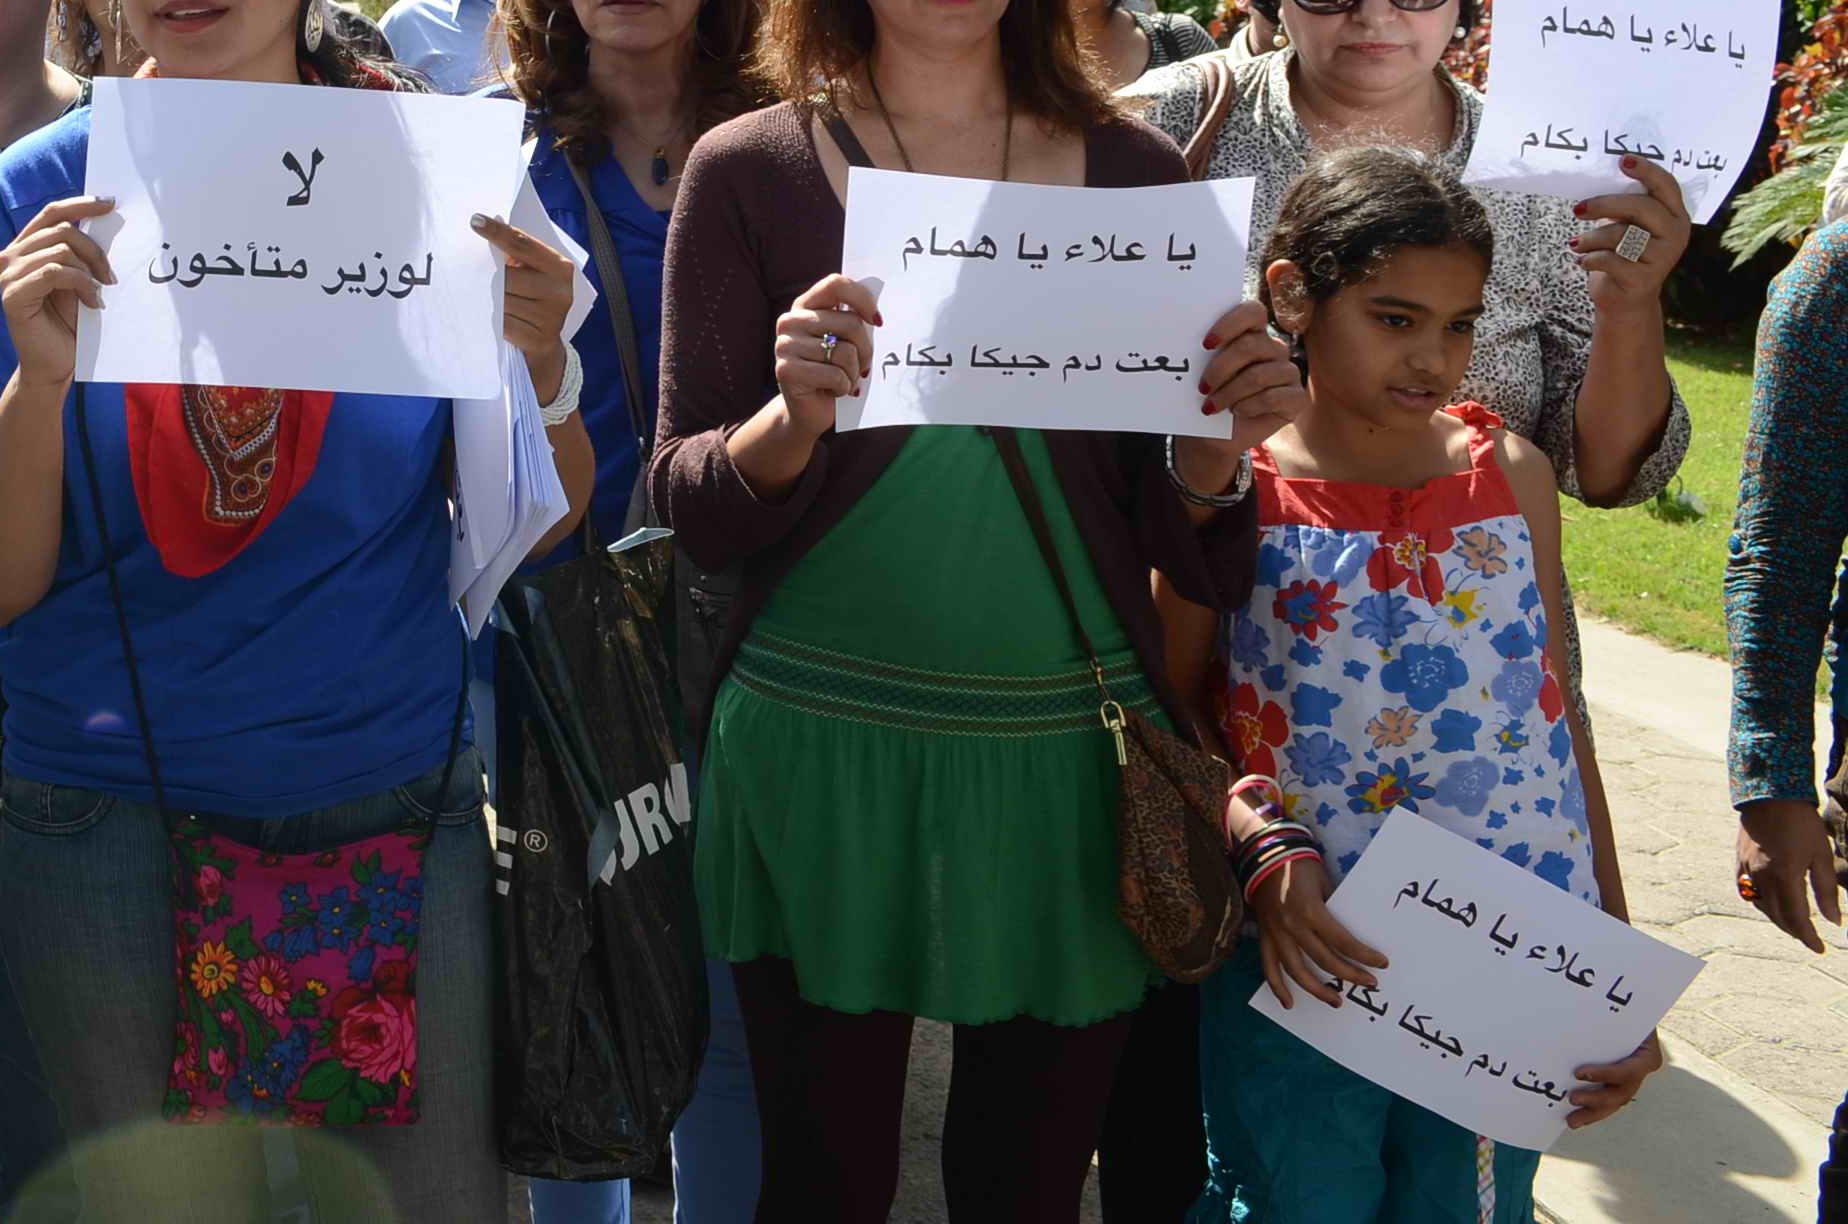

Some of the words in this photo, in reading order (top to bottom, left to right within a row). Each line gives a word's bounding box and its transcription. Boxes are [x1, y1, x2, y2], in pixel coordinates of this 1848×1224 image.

[1540, 6, 1615, 48] همام
[1630, 14, 1652, 53] يا
[1664, 22, 1716, 52] علاء
[1728, 30, 1745, 68] يا
[1521, 124, 1588, 161] بكام
[282, 147, 325, 207] لا
[148, 241, 308, 288] متأخون
[902, 226, 997, 271] همام
[1017, 232, 1048, 269] يا
[1065, 233, 1147, 264] علاء
[1167, 233, 1197, 271] يا
[322, 251, 433, 299] لوزير
[882, 343, 953, 380] بكام
[970, 344, 1050, 377] جيكا
[1062, 352, 1102, 383] دم
[1116, 352, 1190, 381] بعت
[1393, 879, 1478, 927] همام
[1488, 914, 1520, 956] يا
[1526, 944, 1597, 989] علاء
[1606, 976, 1634, 1013] يا
[1398, 1005, 1464, 1059] جيكا
[1465, 1053, 1508, 1079] دم
[1513, 1069, 1567, 1108] بعت
